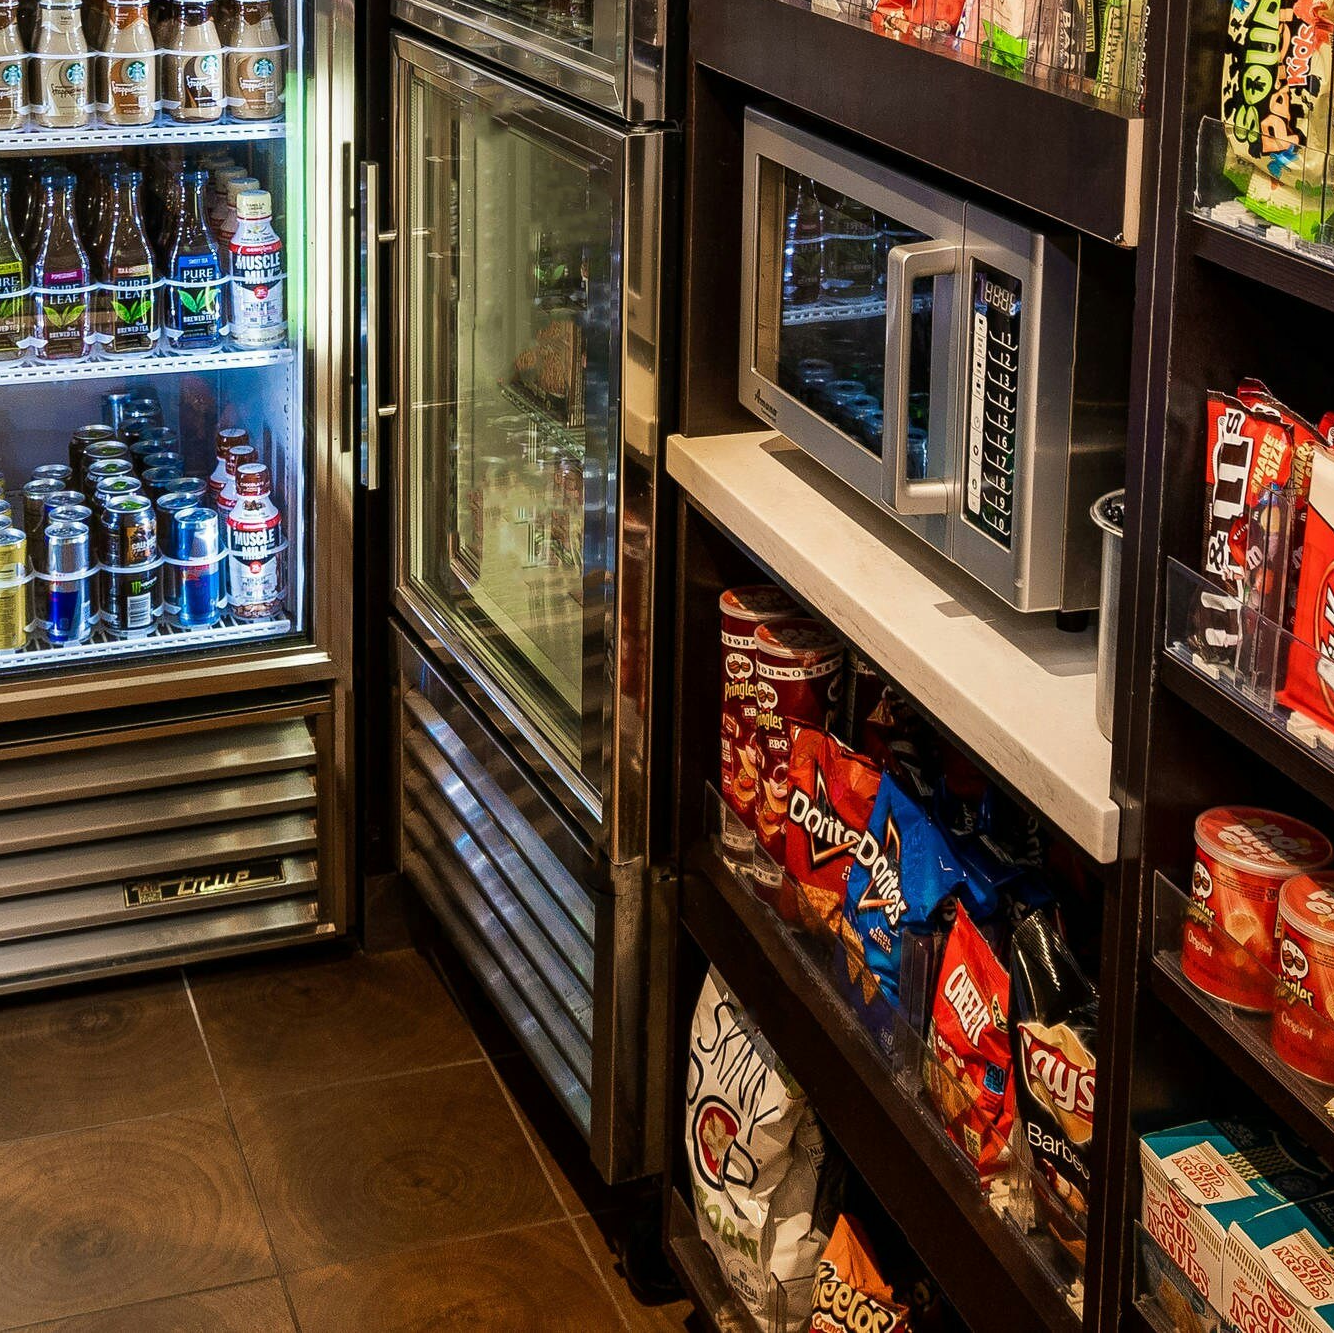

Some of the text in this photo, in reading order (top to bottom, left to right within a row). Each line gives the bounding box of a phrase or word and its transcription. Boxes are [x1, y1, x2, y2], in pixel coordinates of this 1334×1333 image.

[1287, 24, 1317, 90] Kids
[236, 252, 281, 270] MUSCLE
[183, 268, 213, 279] PURE
[244, 267, 275, 284] MILK
[49, 294, 80, 305] LEAF
[1268, 441, 1287, 482] SIZE
[233, 528, 275, 547] MUSCLE
[724, 681, 758, 702] Pringles
[768, 739, 789, 751] BBQ
[790, 788, 862, 855] Doritos
[856, 830, 907, 925] Doritos
[869, 928, 892, 954] RANCH
[875, 926, 892, 946] COOL
[696, 1000, 780, 1147] SKINNY
